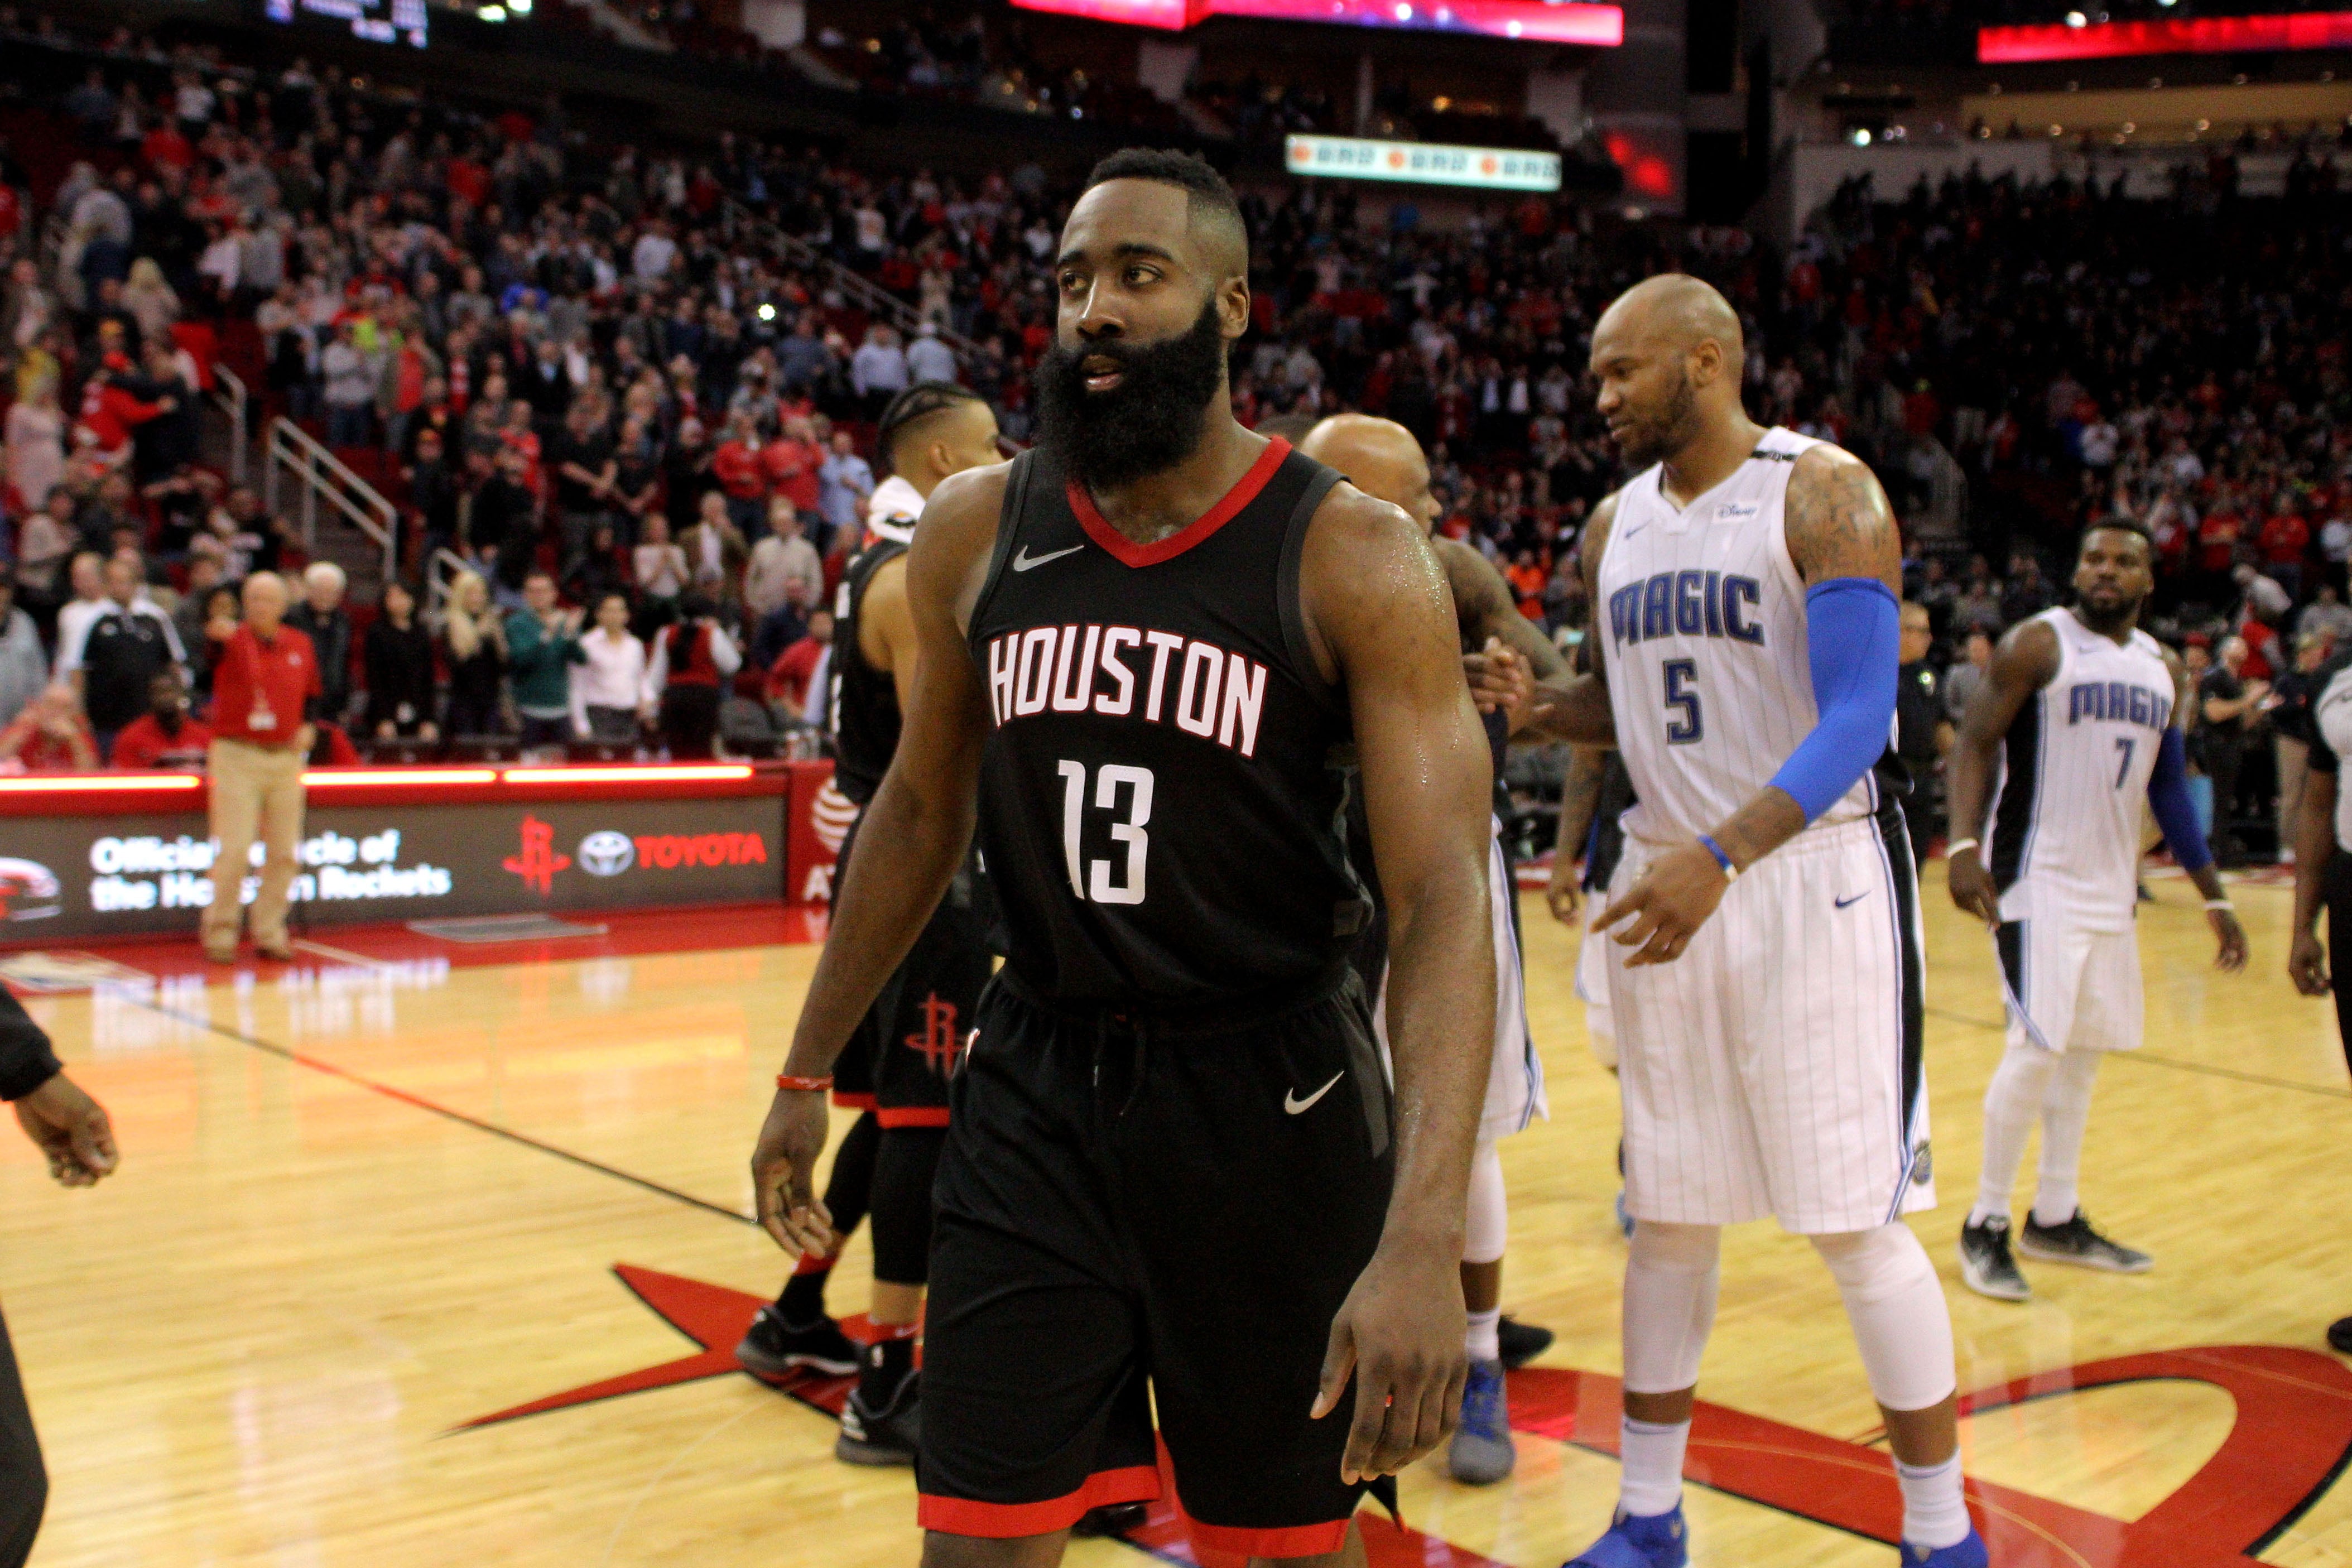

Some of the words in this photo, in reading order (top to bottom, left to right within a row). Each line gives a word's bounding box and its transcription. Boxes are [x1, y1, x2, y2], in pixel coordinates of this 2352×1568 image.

[1609, 569, 1766, 660] MAGIC
[989, 623, 1268, 759] HOUSTON
[1662, 657, 1705, 745] 5
[2115, 737, 2137, 790] 7
[360, 828, 401, 865] of
[634, 833, 768, 869] TOYOTA
[1058, 759, 1155, 905] 13
[91, 873, 158, 912] the
[319, 863, 453, 901] Rockets
